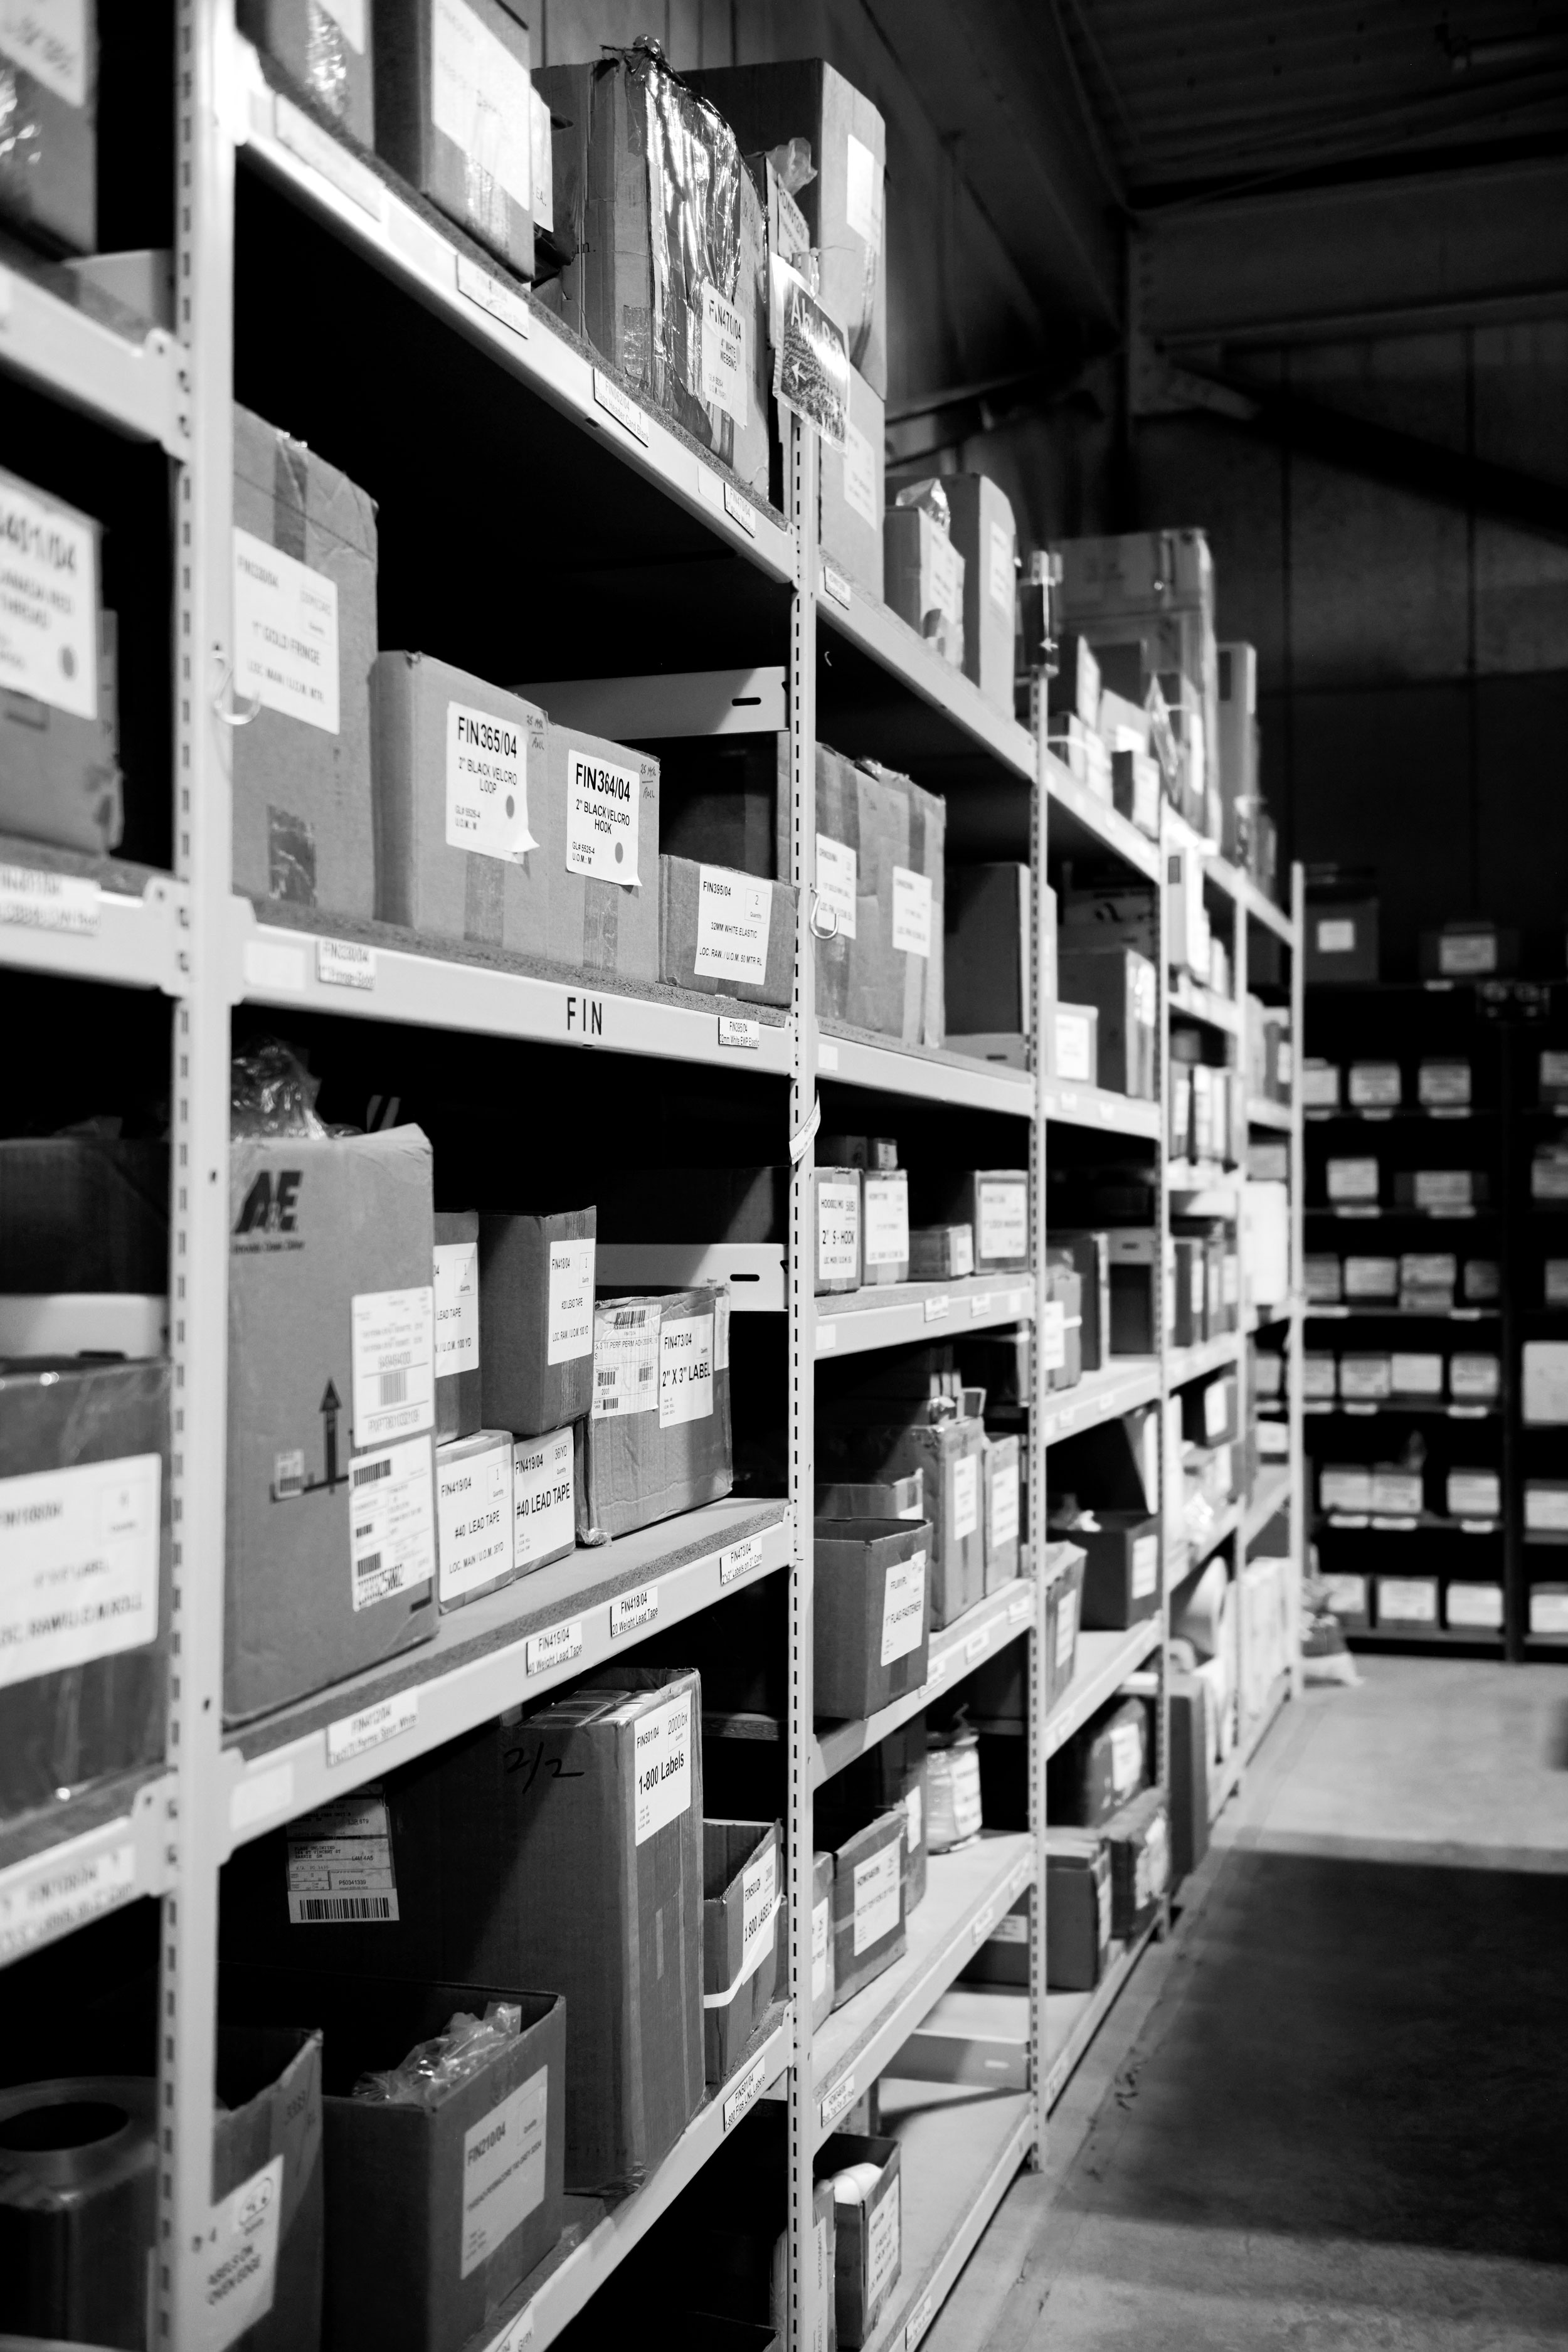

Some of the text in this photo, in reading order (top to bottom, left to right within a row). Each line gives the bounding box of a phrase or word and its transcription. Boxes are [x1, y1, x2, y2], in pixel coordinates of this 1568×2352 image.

[721, 350, 737, 371] WEBBING
[726, 341, 736, 358] WHITE
[605, 381, 630, 411] FIN062/04
[610, 399, 625, 420] Header
[626, 416, 637, 432] Card
[637, 425, 649, 442] Blank
[264, 627, 289, 654] GOLD
[290, 637, 321, 666] FRINGE
[458, 716, 517, 758] FIN365/04
[458, 756, 517, 785] 2" BLACK VELCRO
[640, 763, 646, 775] 25
[480, 778, 497, 794] LOOP
[576, 763, 630, 802] FIN364/04
[576, 799, 630, 826] 2" BLACK VELCRO
[595, 818, 612, 834] HOOK
[572, 841, 595, 854] GL# 5525-4
[703, 881, 759, 905] FIN395/04 2
[750, 911, 762, 920] Quantity
[711, 921, 758, 939] 32MM WHITE ELASTIC
[699, 947, 710, 957] LOC.
[741, 955, 745, 963] 50
[746, 955, 756, 965] MTR
[756, 957, 762, 966] RL
[567, 996, 602, 1036] FIN
[729, 1021, 748, 1033] FIN395/04
[719, 1034, 730, 1044] 32mm
[731, 1035, 740, 1045] White
[749, 1037, 760, 1047] Elastic
[232, 1170, 303, 1234] AE
[464, 1263, 467, 1275] 1
[551, 1258, 570, 1270] FIN418/04
[437, 1308, 461, 1321] LEAD TAPE
[567, 1299, 575, 1310] LEAD
[575, 1297, 583, 1307] TAPE
[585, 1325, 588, 1335] YD
[664, 1333, 692, 1350] FIN473/04
[465, 1337, 471, 1348] YD
[610, 1341, 621, 1349] PERF
[662, 1362, 711, 1387] 2" X 3" LABEL
[516, 1453, 543, 1475] FIN419/04
[556, 1466, 566, 1475] Quantity
[441, 1468, 499, 1498] FIN419/04 1
[493, 1489, 504, 1498] Quantity
[516, 1482, 570, 1520] #40 LEAD TAPE
[455, 1510, 500, 1539] #40 LEAD TAPE
[463, 1553, 476, 1568] MAIN
[731, 1542, 751, 1564] FIN473/04
[733, 1564, 744, 1578] Labels
[744, 1564, 749, 1573] on
[754, 1553, 762, 1565] Core
[621, 1591, 647, 1615] FIN418/04
[613, 1606, 659, 1635] 20 Weight Lead Tape
[538, 1626, 569, 1653] FIN419/04
[535, 1655, 556, 1674] Weight
[556, 1650, 568, 1665] Lead
[569, 1643, 582, 1661] Tape
[400, 1713, 417, 1729] White
[637, 1712, 688, 1749] FIN501/04 2000/bx
[504, 1742, 585, 1793] 2/2
[638, 1750, 684, 1795] 1-800 Labels
[758, 1898, 772, 1927] LABELS
[725, 2074, 766, 2128] 1-800 Labels
[735, 2074, 754, 2104] FIN501/04
[467, 2122, 507, 2166] FIN210/04
